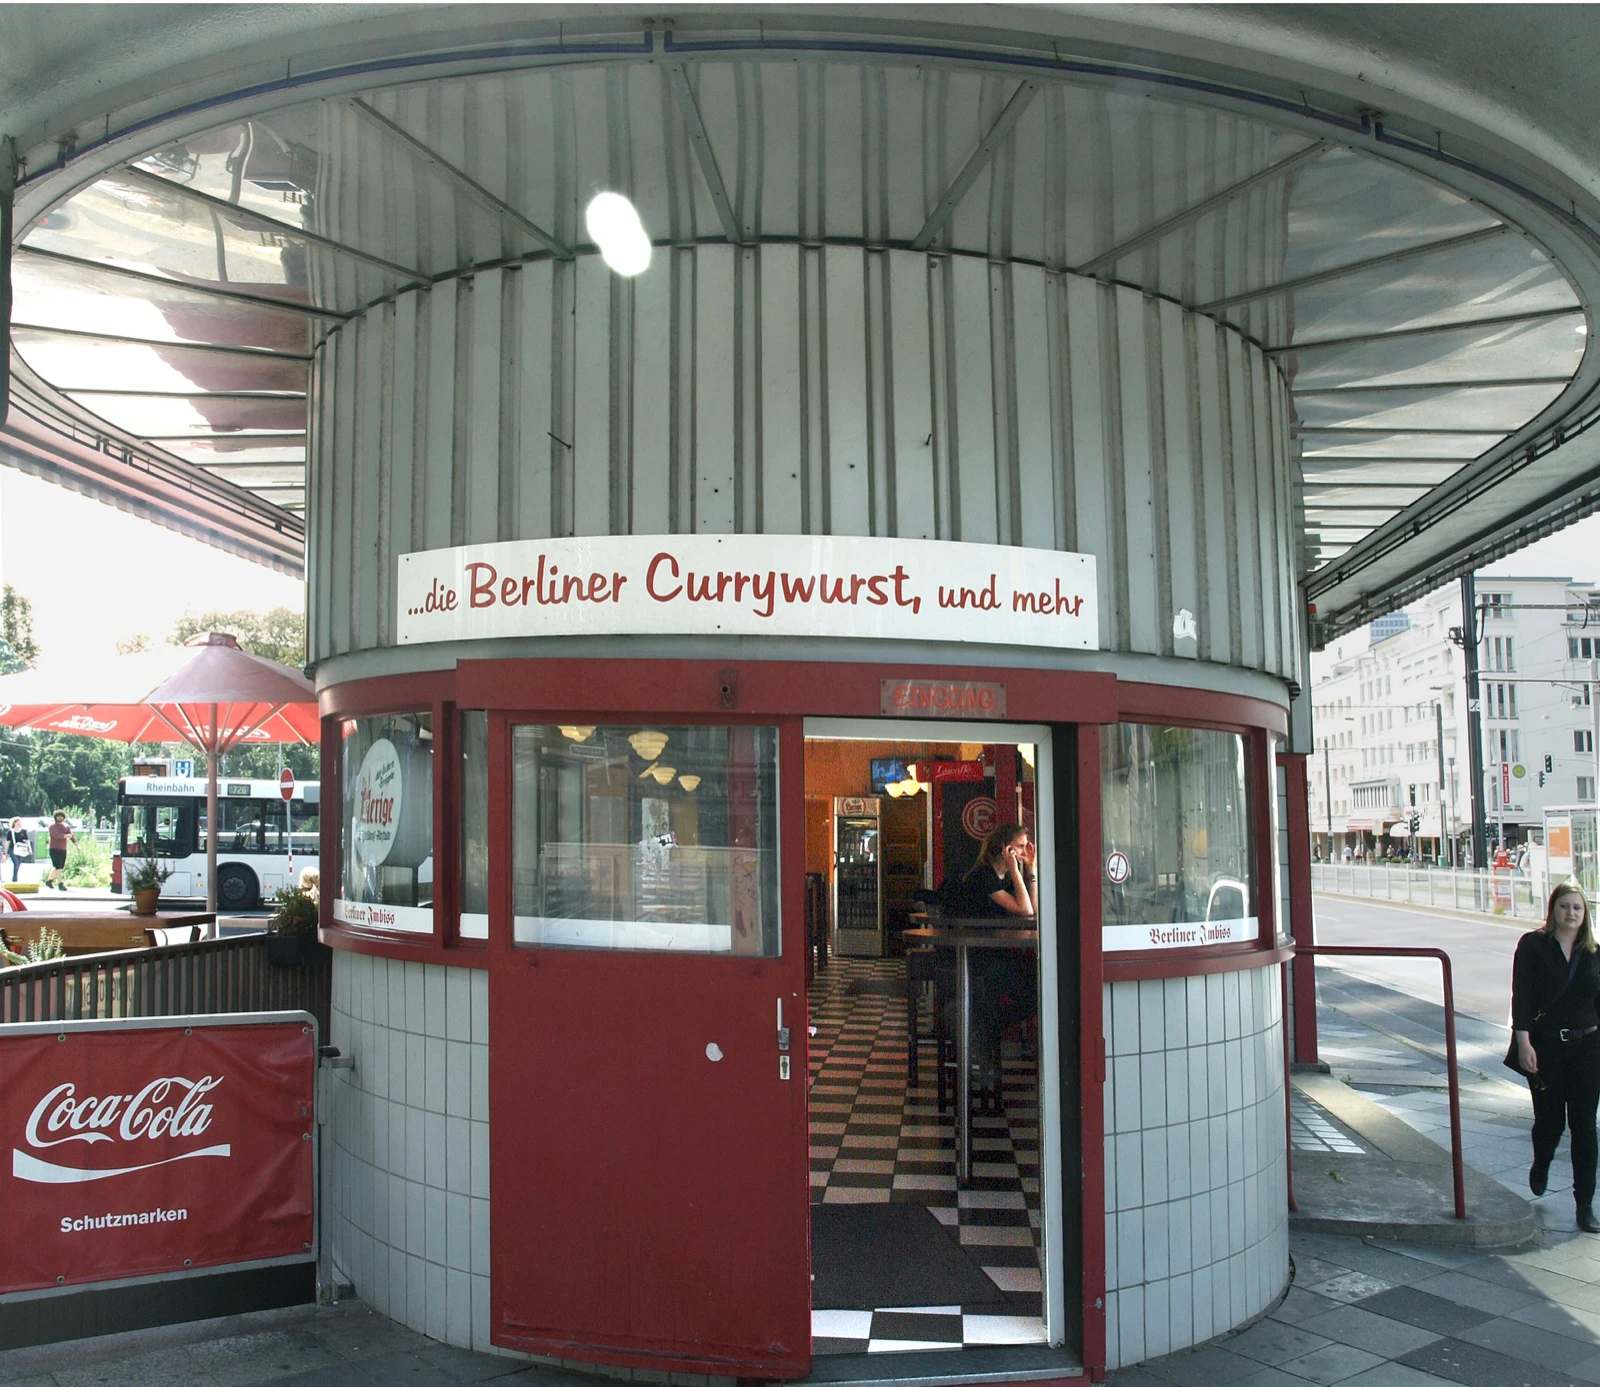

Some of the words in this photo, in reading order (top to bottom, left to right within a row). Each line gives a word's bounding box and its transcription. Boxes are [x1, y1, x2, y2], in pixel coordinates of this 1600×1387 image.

[408, 578, 458, 615] ...die
[467, 556, 627, 608] Berliner
[646, 552, 922, 617] Currywurst,
[937, 575, 1001, 610] und
[1012, 578, 1085, 617] mehr
[146, 782, 195, 793] Rheinbahn
[367, 905, 395, 925] Imbiss
[1149, 927, 1197, 944] Berliner
[1199, 924, 1232, 944] Imbiss
[26, 1075, 225, 1148] Coca-Cola
[60, 1207, 187, 1233] Schutzmarken
